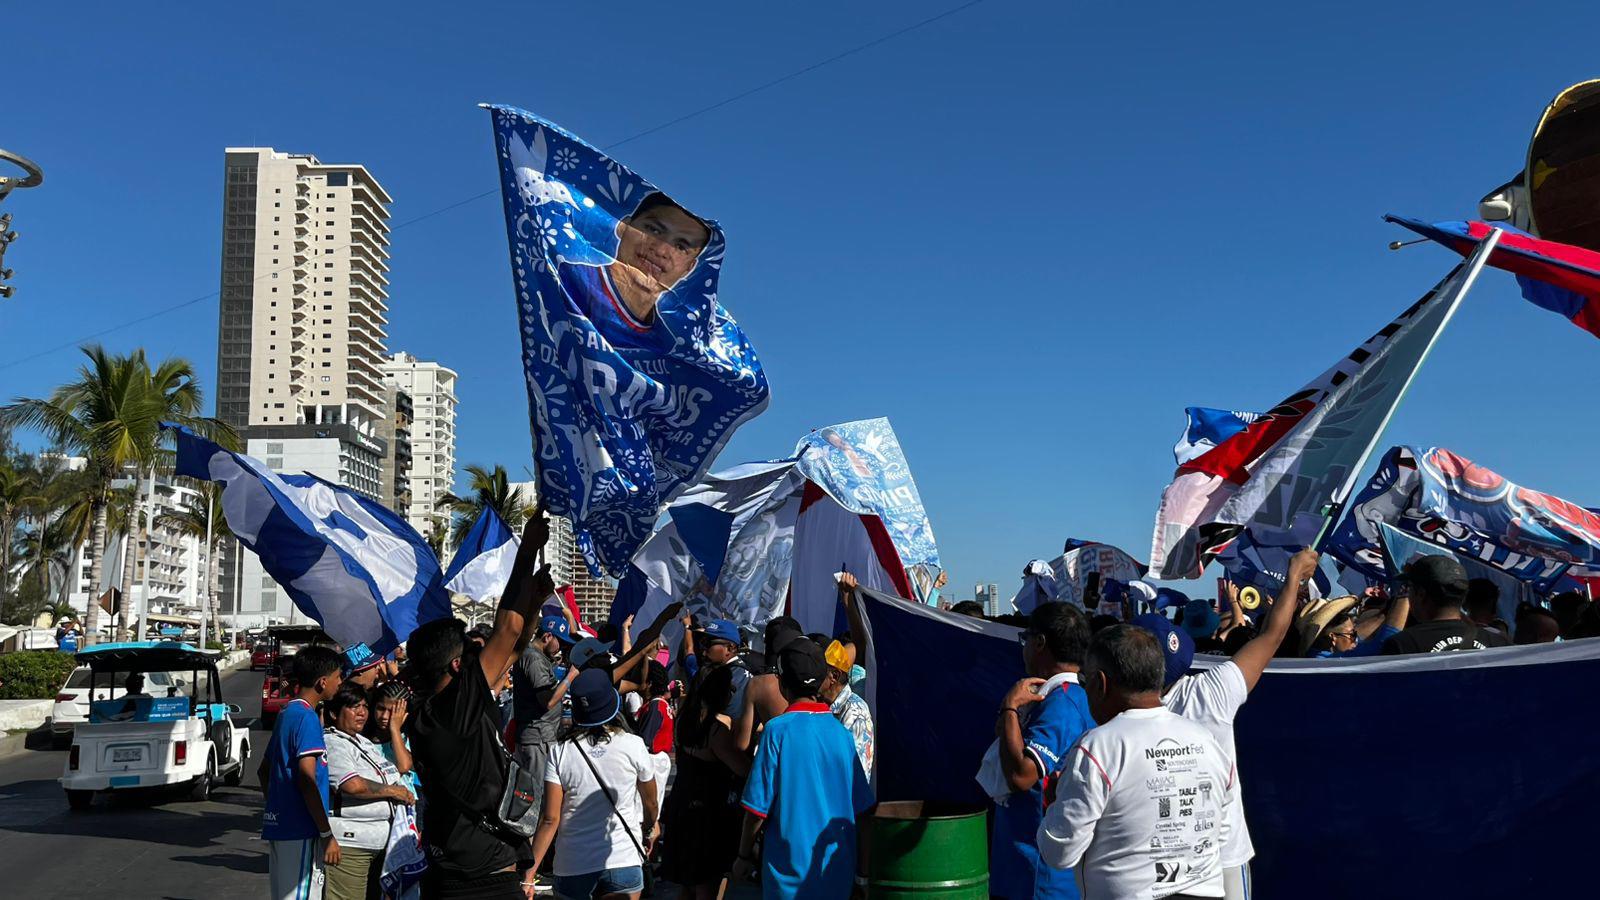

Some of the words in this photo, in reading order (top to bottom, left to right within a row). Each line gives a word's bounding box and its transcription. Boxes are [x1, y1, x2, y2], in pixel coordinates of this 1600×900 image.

[1178, 787, 1198, 796] TABLE
[1179, 797, 1194, 807] TALK
[1179, 808, 1193, 817] PIES
